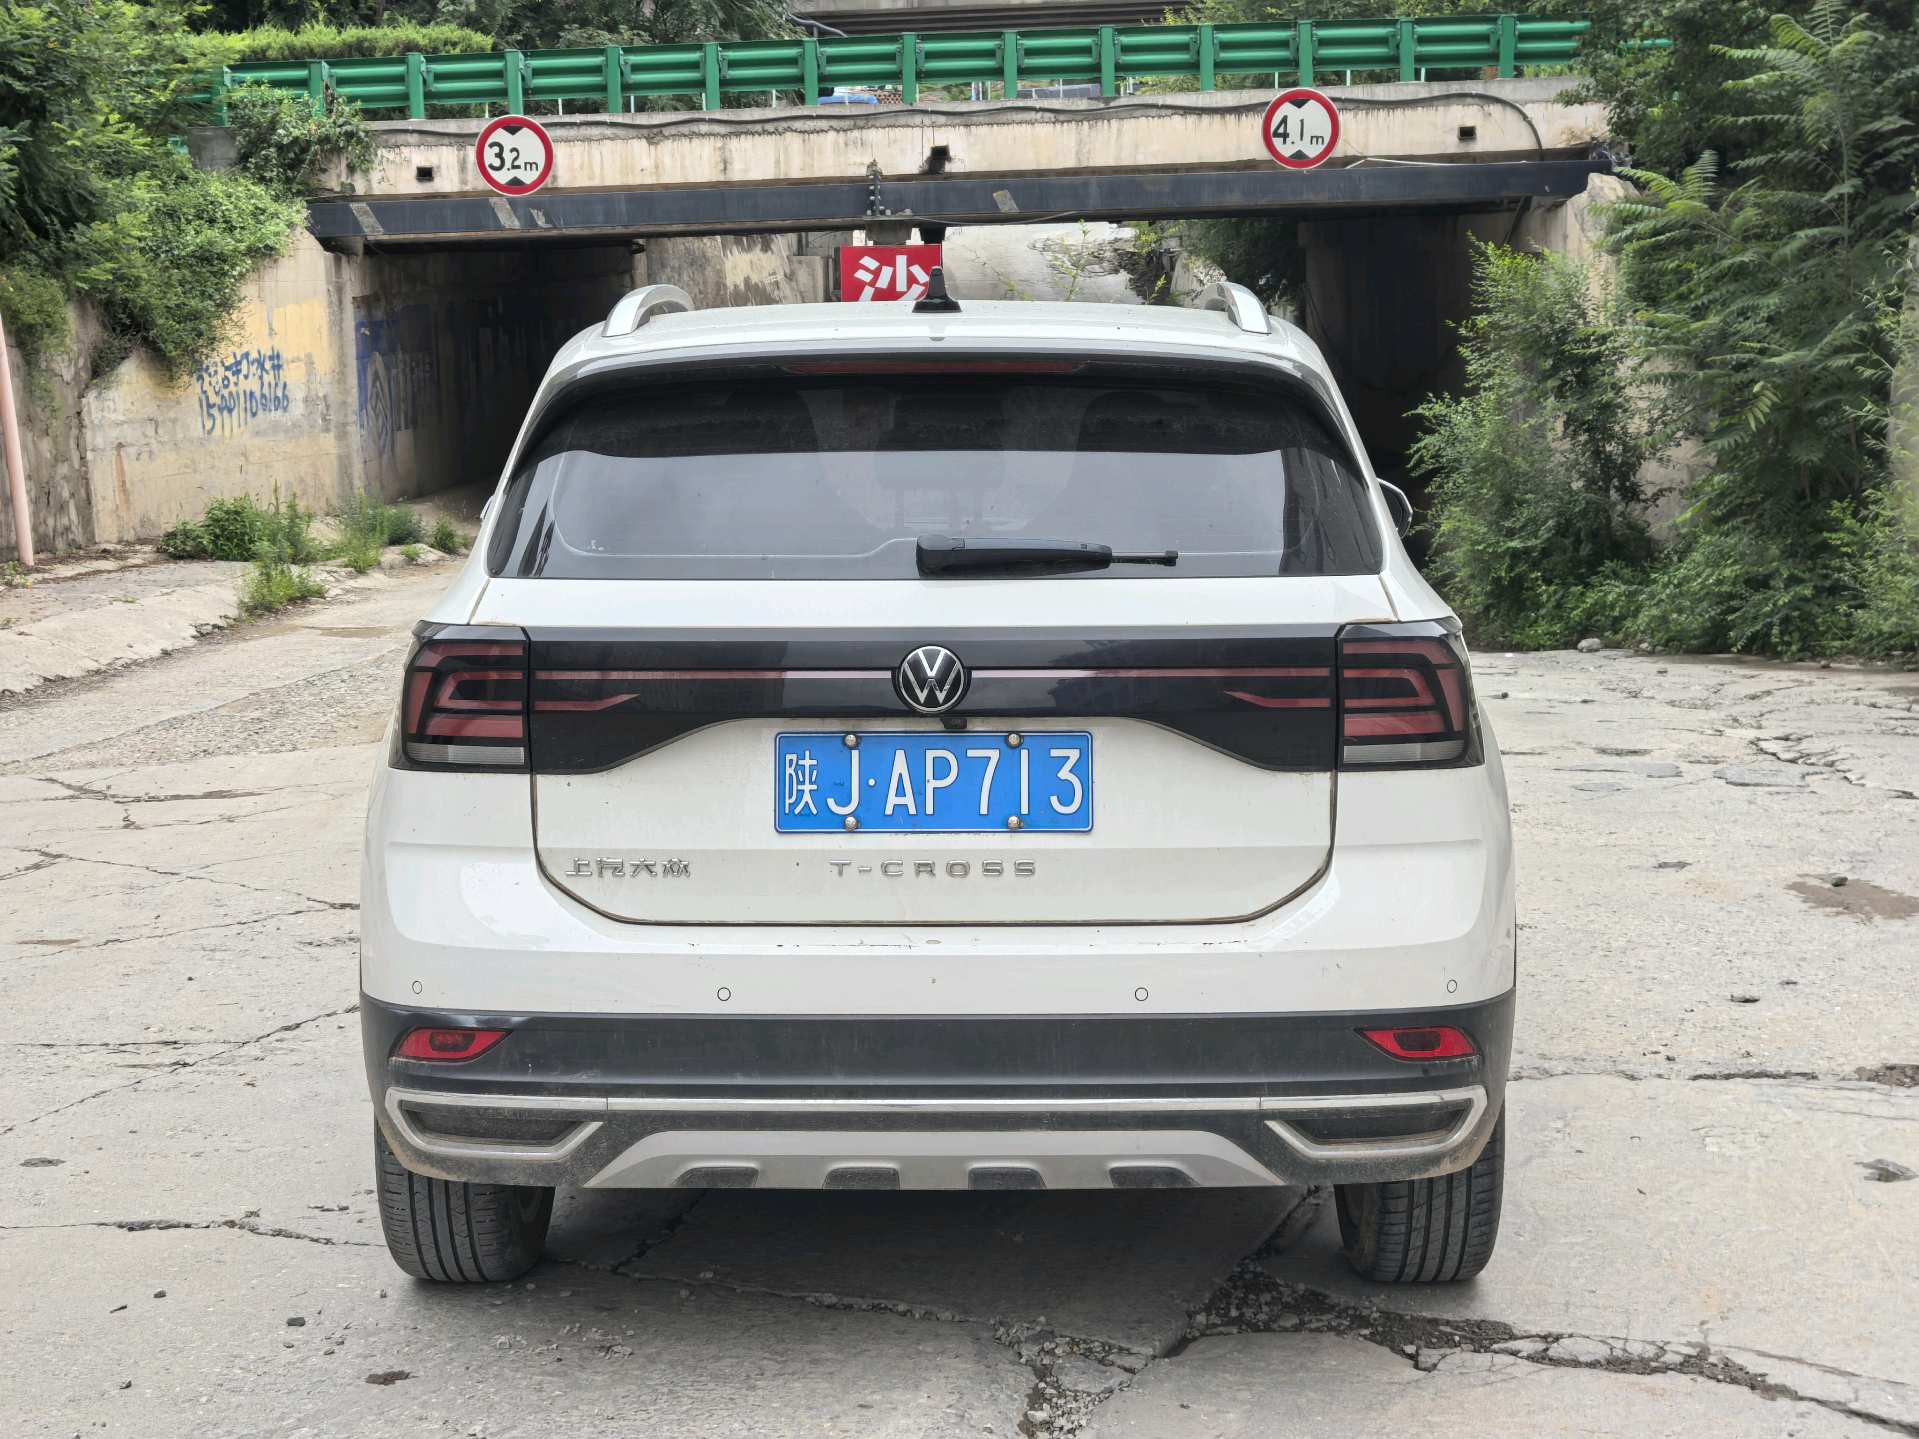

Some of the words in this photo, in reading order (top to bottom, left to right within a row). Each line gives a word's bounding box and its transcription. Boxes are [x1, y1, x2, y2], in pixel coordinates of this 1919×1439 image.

[1272, 114, 1325, 145] 4.1m
[488, 141, 539, 171] 3.2m
[853, 254, 930, 301] 沙
[565, 858, 690, 878] 上汽大众
[829, 860, 1036, 877] T-CROSS
